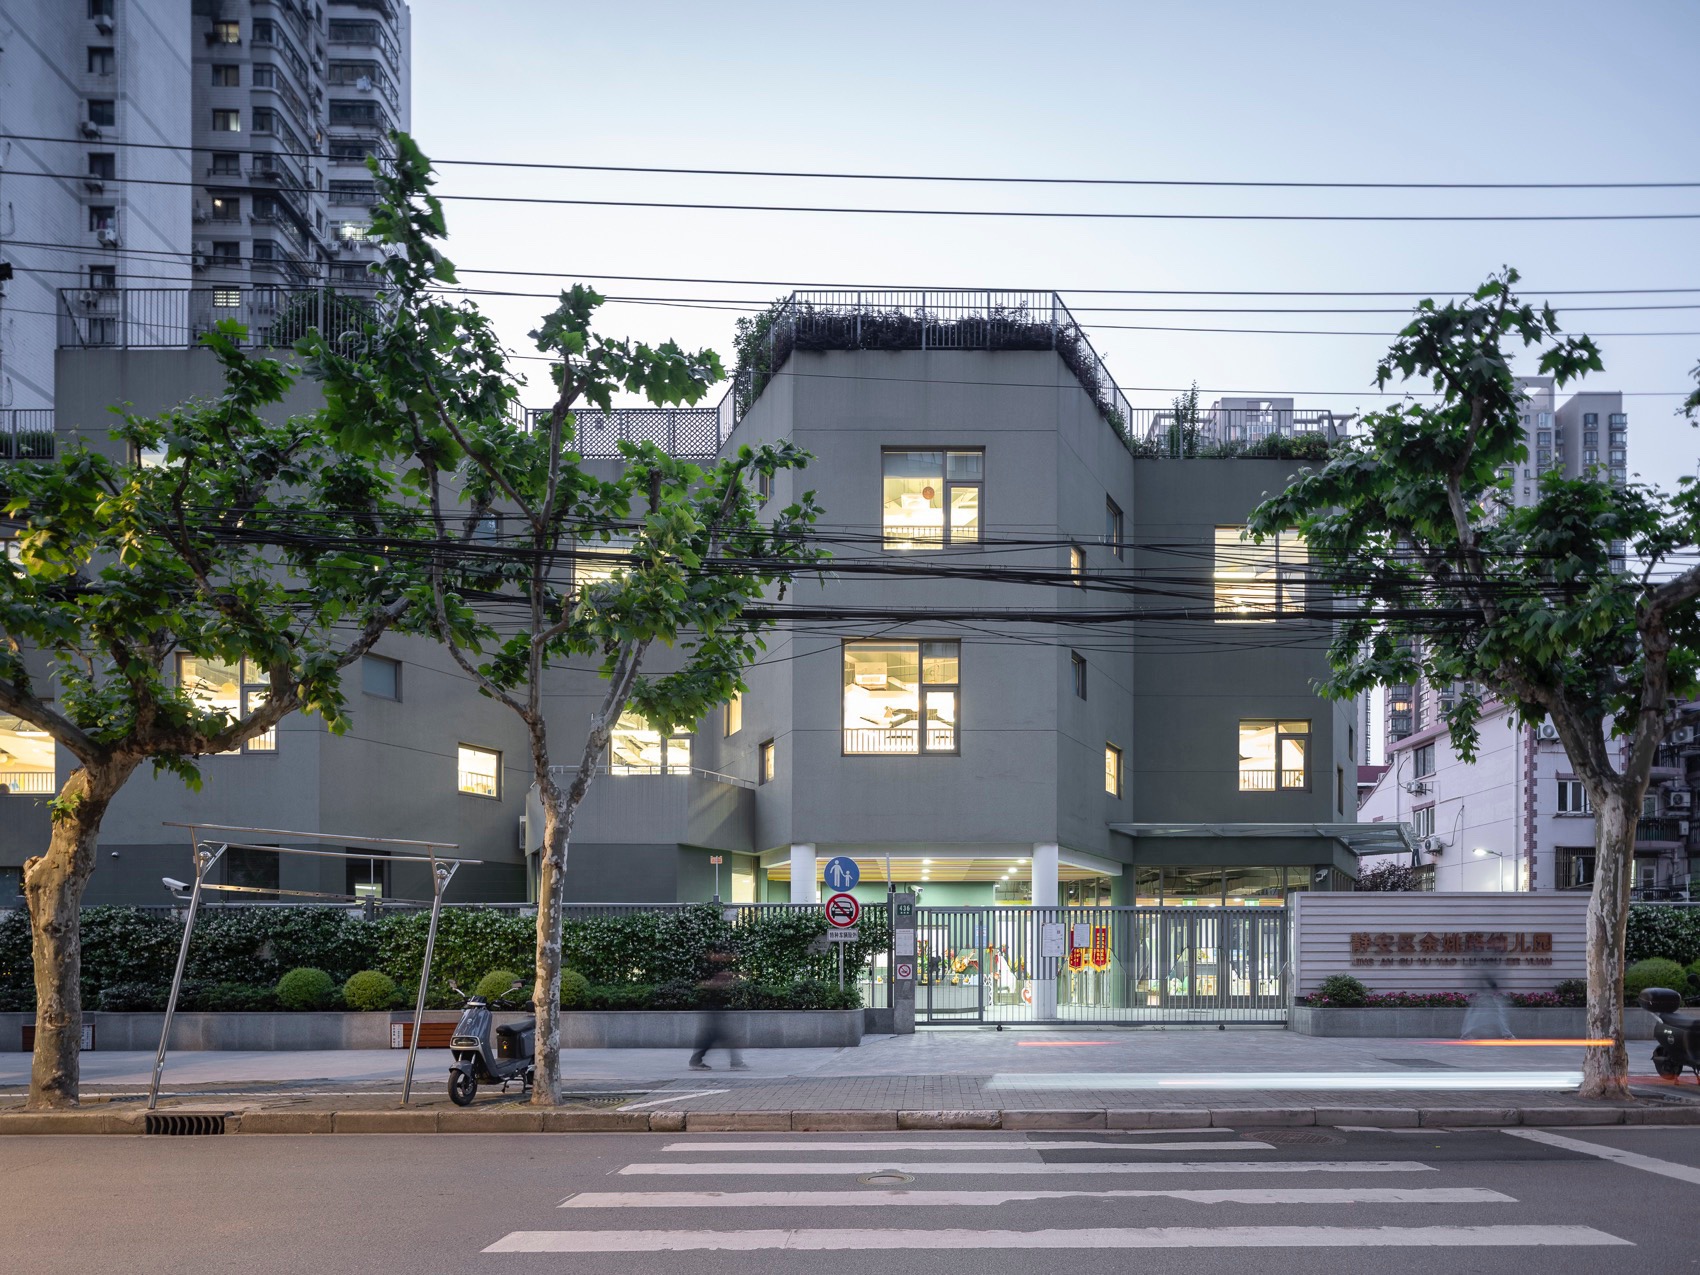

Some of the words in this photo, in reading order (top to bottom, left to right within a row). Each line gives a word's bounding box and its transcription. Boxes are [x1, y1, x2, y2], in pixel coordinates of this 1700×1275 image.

[1350, 932, 1553, 953] 静安区余姚路幼儿园
